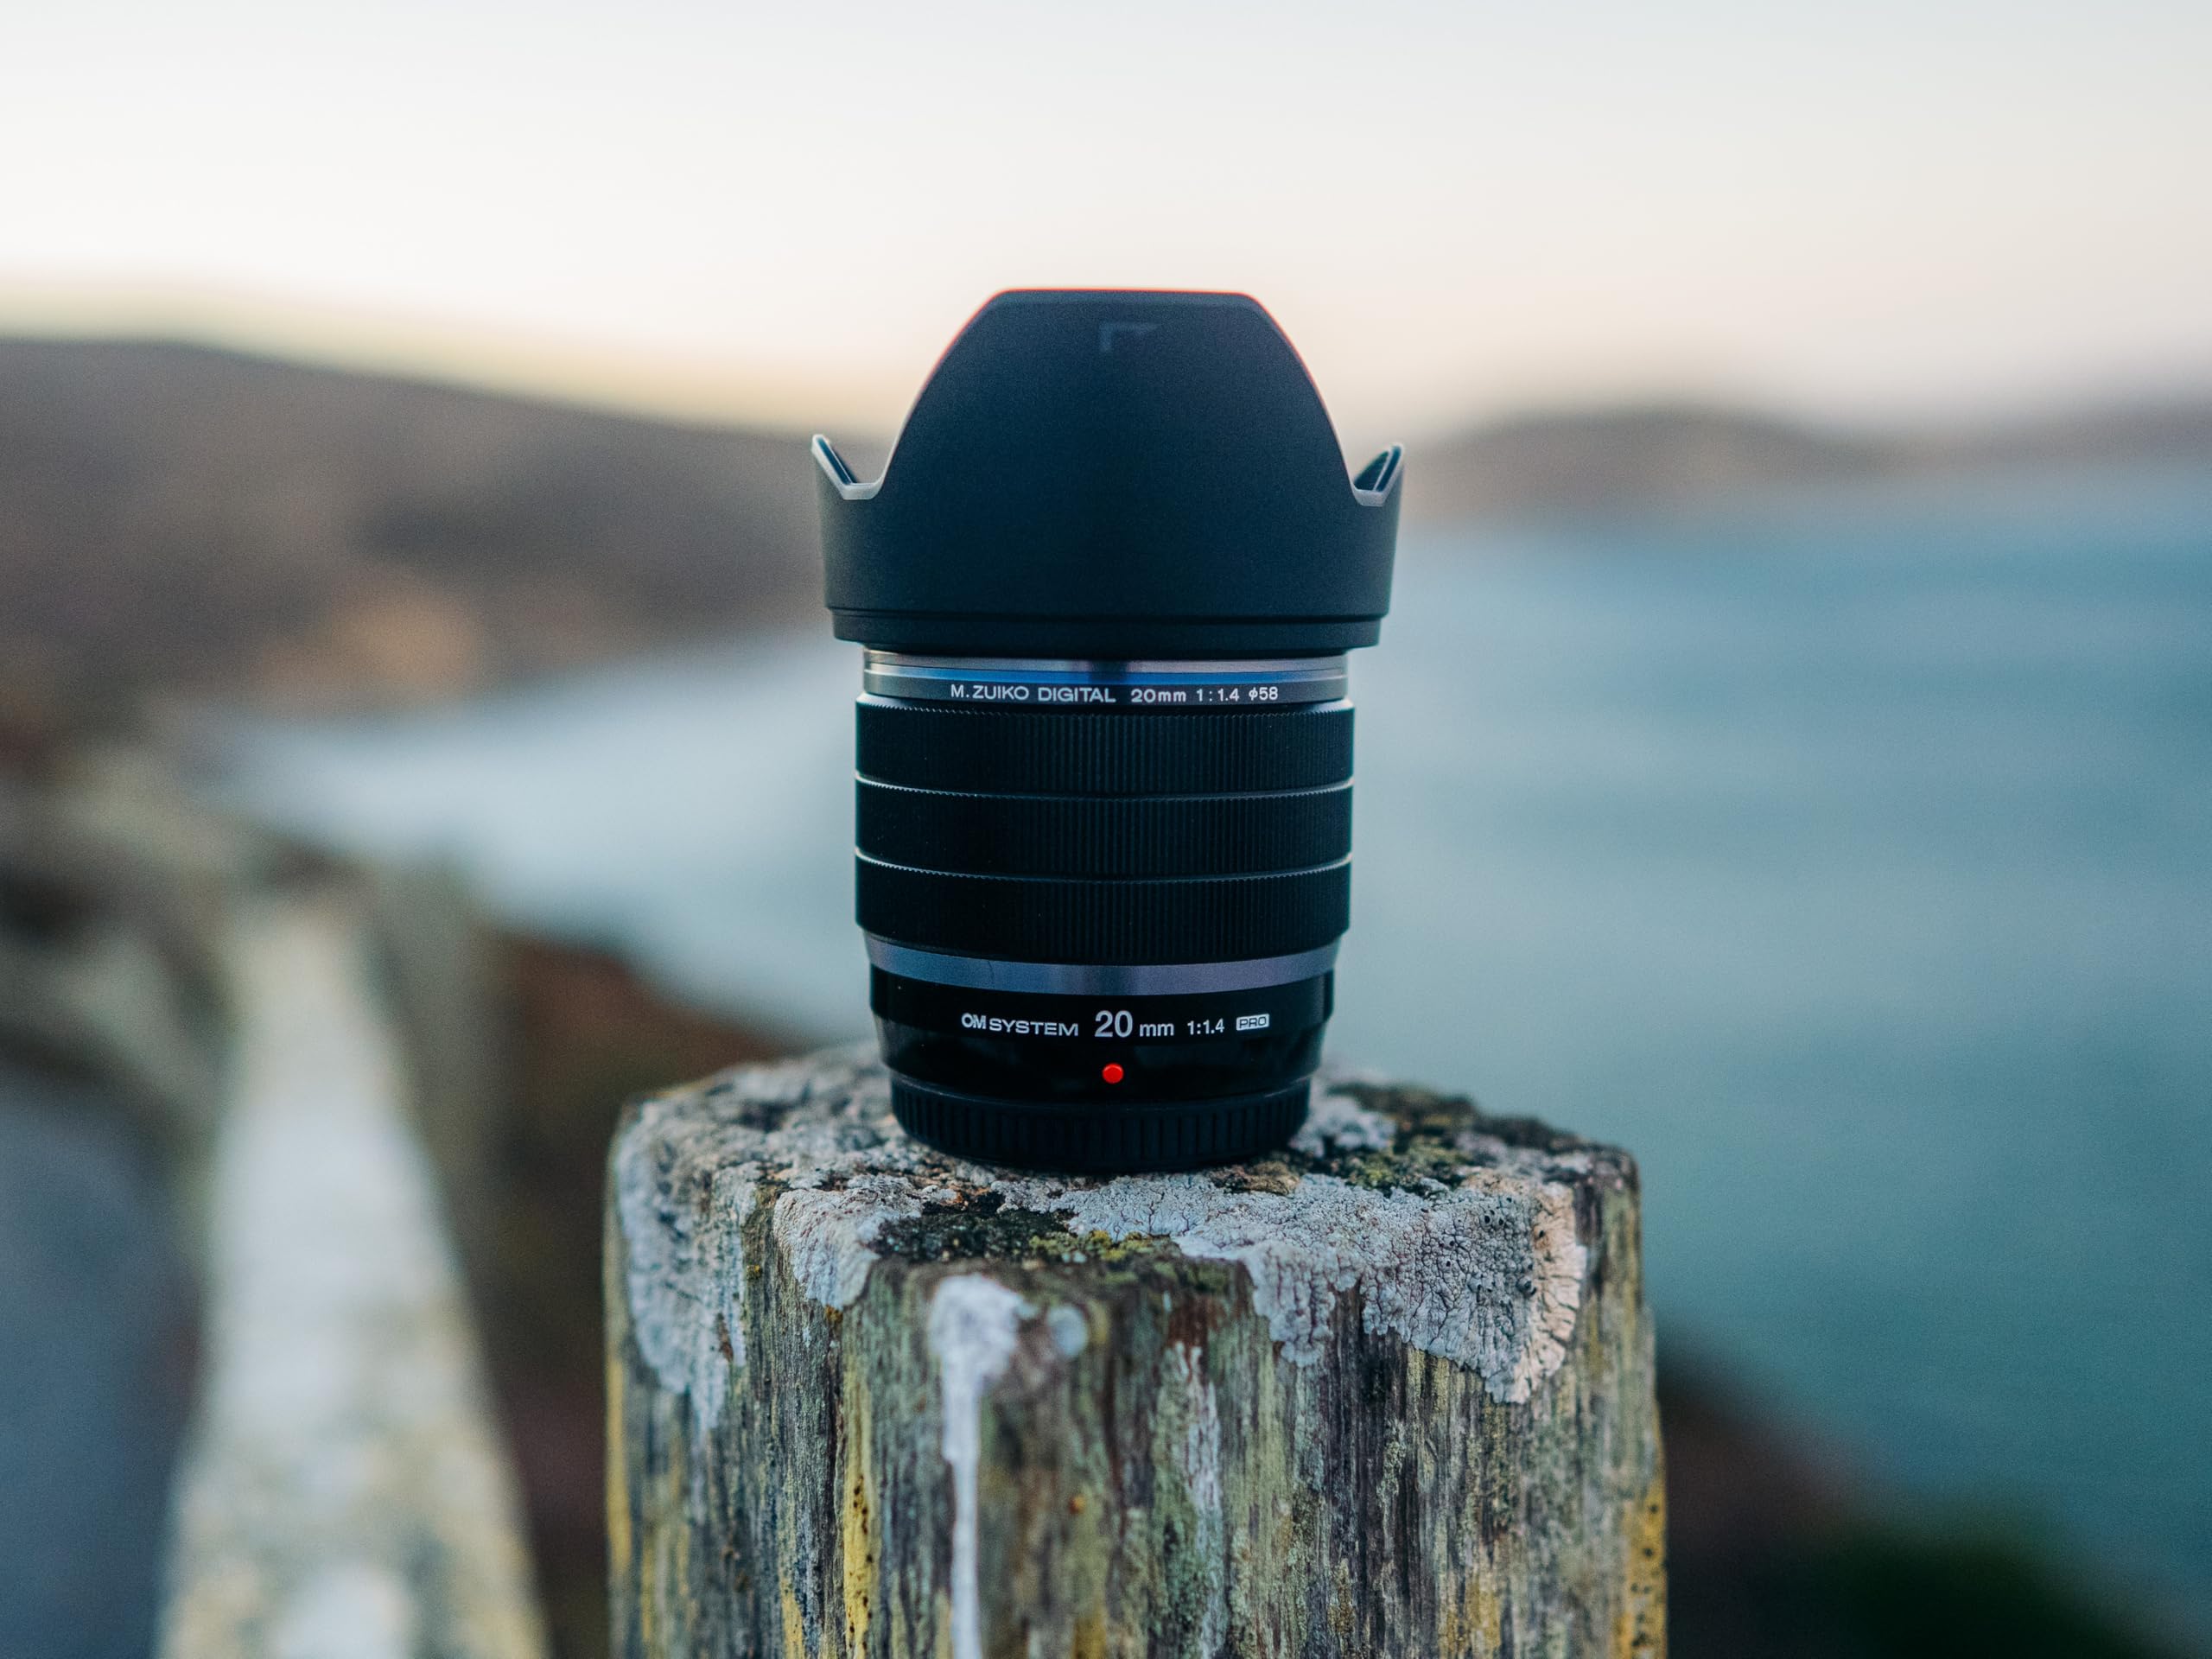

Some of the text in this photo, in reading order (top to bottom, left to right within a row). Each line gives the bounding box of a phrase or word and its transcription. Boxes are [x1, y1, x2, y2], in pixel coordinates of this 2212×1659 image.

[950, 684, 1029, 701] M.ZUIKO
[1038, 687, 1116, 702] DIGITAL
[1131, 689, 1186, 703] 20mm
[988, 1018, 1078, 1037] SYSTEM
[1094, 1009, 1133, 1038] 20
[1139, 1022, 1174, 1037] mm
[1186, 1019, 1224, 1035] 1:1.4
[1236, 1014, 1269, 1031] PRO
